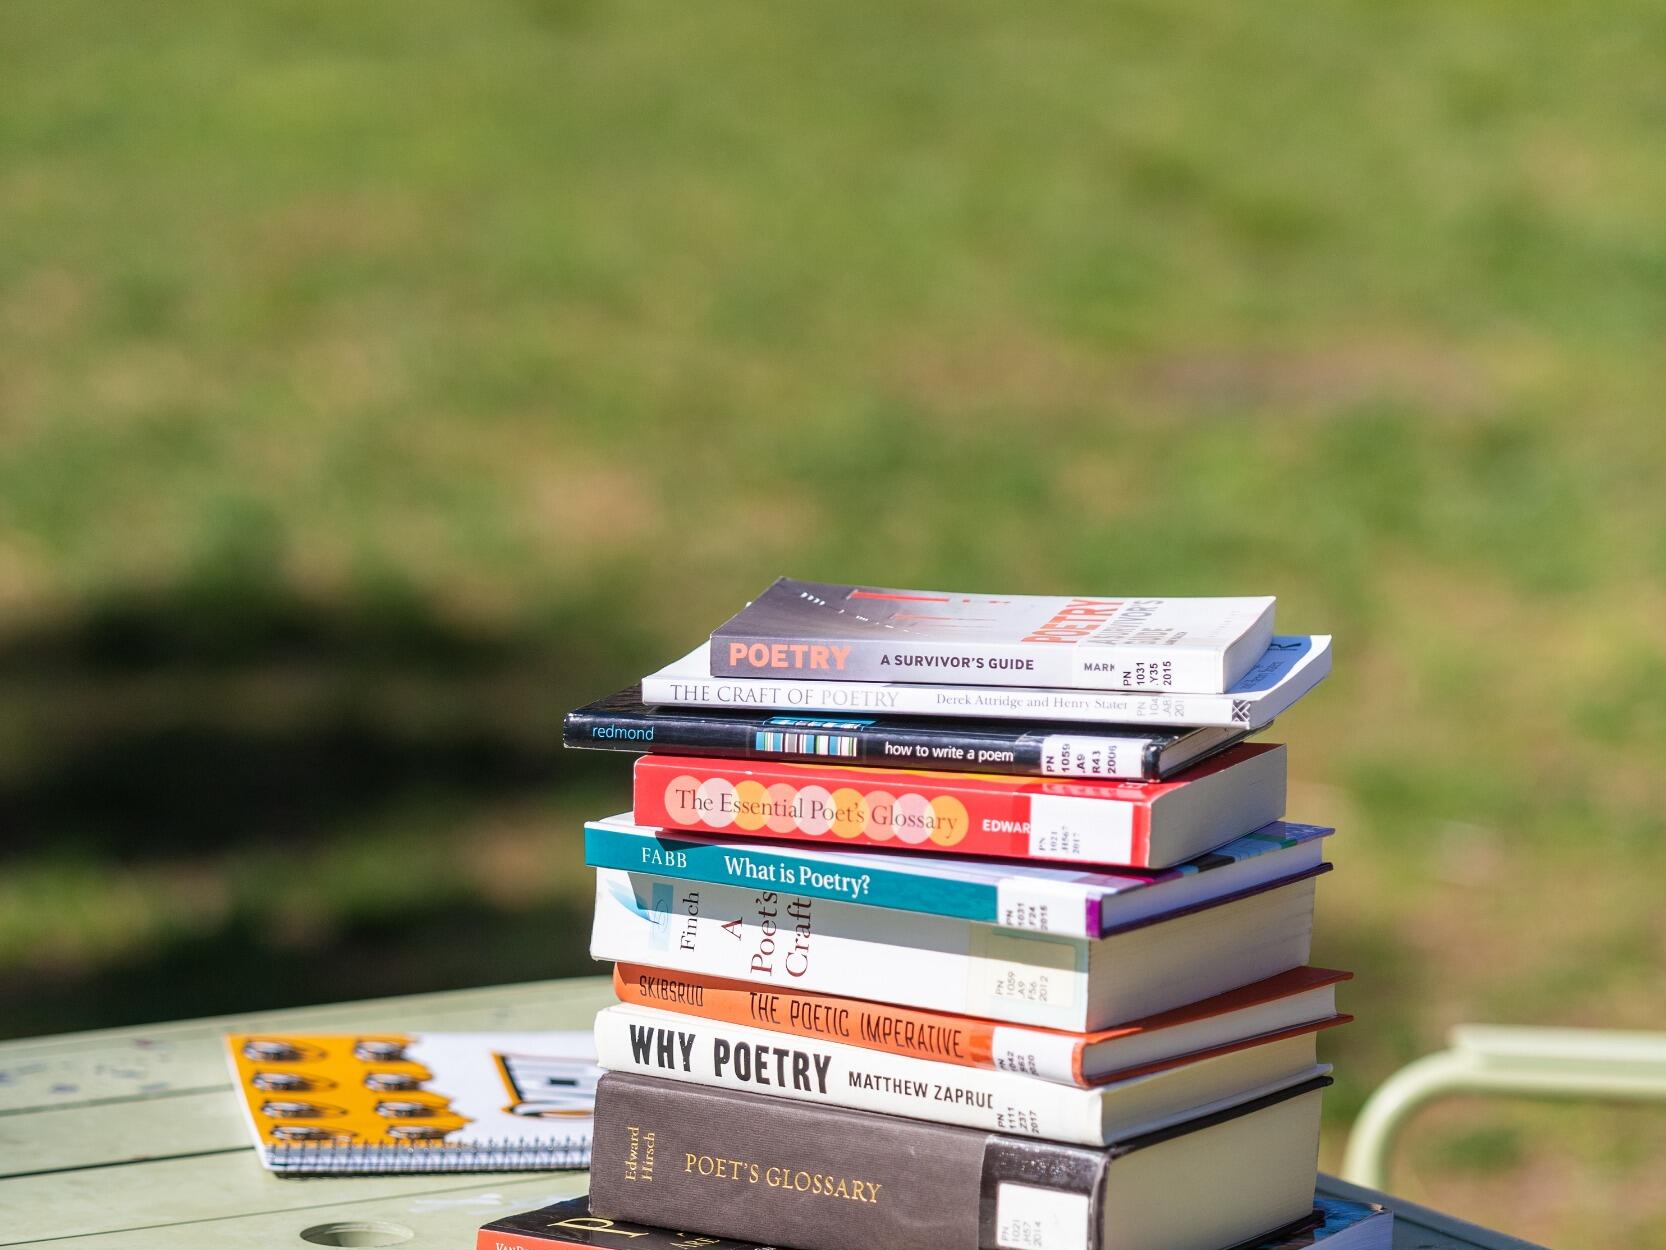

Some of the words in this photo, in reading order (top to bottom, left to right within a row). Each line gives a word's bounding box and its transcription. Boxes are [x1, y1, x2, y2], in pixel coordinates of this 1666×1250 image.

[1021, 598, 1126, 644] POETRY
[728, 643, 852, 670] POETRY
[880, 654, 890, 666] A
[894, 654, 985, 669] SURVIVOR'S
[988, 658, 1034, 670] GUIDE
[1123, 671, 1132, 686] PN
[1136, 662, 1145, 685] 1031
[1163, 661, 1172, 686] 2015
[670, 684, 711, 702] THE
[717, 686, 781, 704] CRAFT
[787, 688, 814, 705] OF
[821, 690, 900, 708] POETRY
[937, 693, 972, 705] Derek
[975, 694, 1023, 708] Attridge
[1027, 699, 1049, 708] and
[592, 725, 654, 741] redmond
[885, 742, 912, 756] how
[916, 745, 929, 757] to
[932, 746, 963, 760] write
[967, 751, 975, 761] a
[978, 752, 1014, 764] poem
[1046, 756, 1056, 773] PN
[676, 789, 714, 811] The
[720, 793, 803, 819] Essential
[811, 801, 865, 823] Poet's
[871, 804, 958, 838] Glossary
[641, 847, 687, 868] FABB
[724, 855, 776, 881] What
[780, 863, 795, 883] is
[800, 866, 870, 898] Poetry?
[680, 891, 699, 952] Finch
[721, 916, 743, 942] A
[785, 898, 812, 978] Craft
[640, 975, 704, 1007] SKIBSRUD
[750, 992, 781, 1025] THE
[790, 1000, 850, 1037] POETIC
[861, 1012, 964, 1058] IMPERATIVE
[629, 1024, 696, 1072] WHY
[714, 1037, 832, 1095] POETRY
[848, 1070, 928, 1098] MATTHEW
[625, 1126, 640, 1181] Edward
[641, 1132, 656, 1182] Hirsch
[766, 1167, 882, 1204] GLOSSARY
